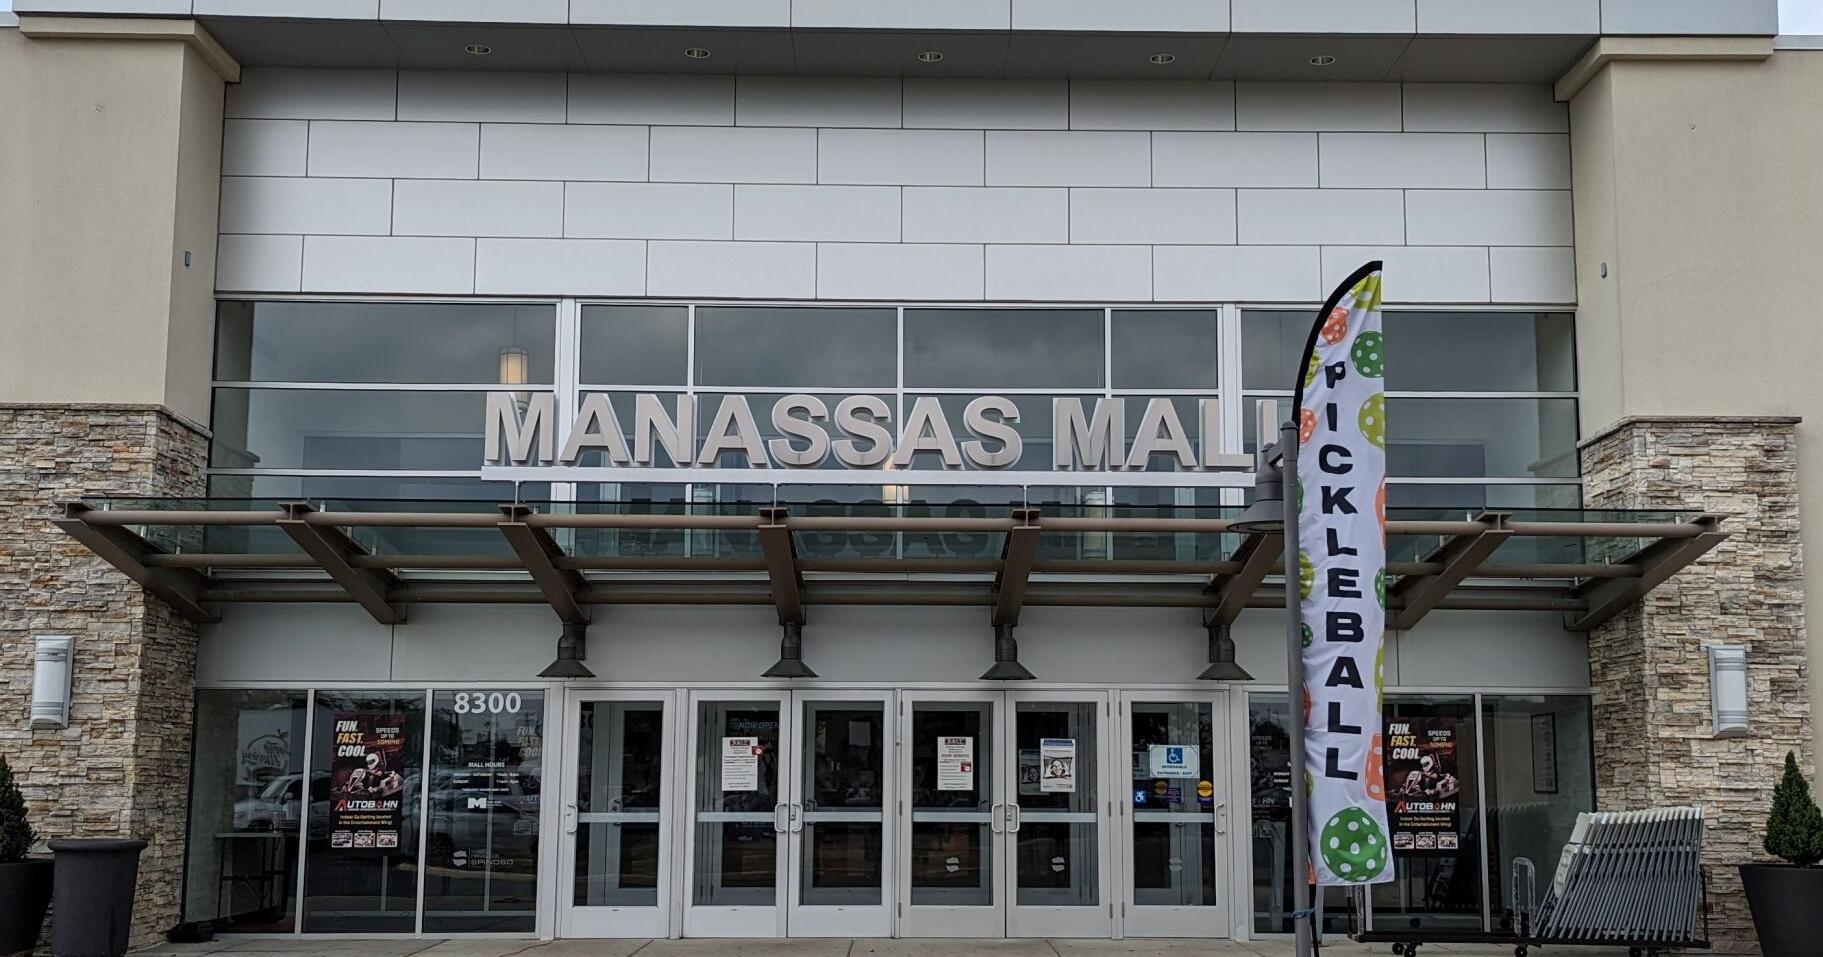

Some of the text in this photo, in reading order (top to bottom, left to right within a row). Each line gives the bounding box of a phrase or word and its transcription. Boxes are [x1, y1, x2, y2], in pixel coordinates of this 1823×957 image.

[485, 391, 1023, 470] MANASSAS
[1318, 361, 1365, 781] PICKLEBALL
[454, 692, 521, 713] 8300
[336, 720, 358, 733] FUN.
[1388, 723, 1411, 735] FUN.
[336, 733, 364, 744] FAST.
[1390, 735, 1417, 747] FAST.
